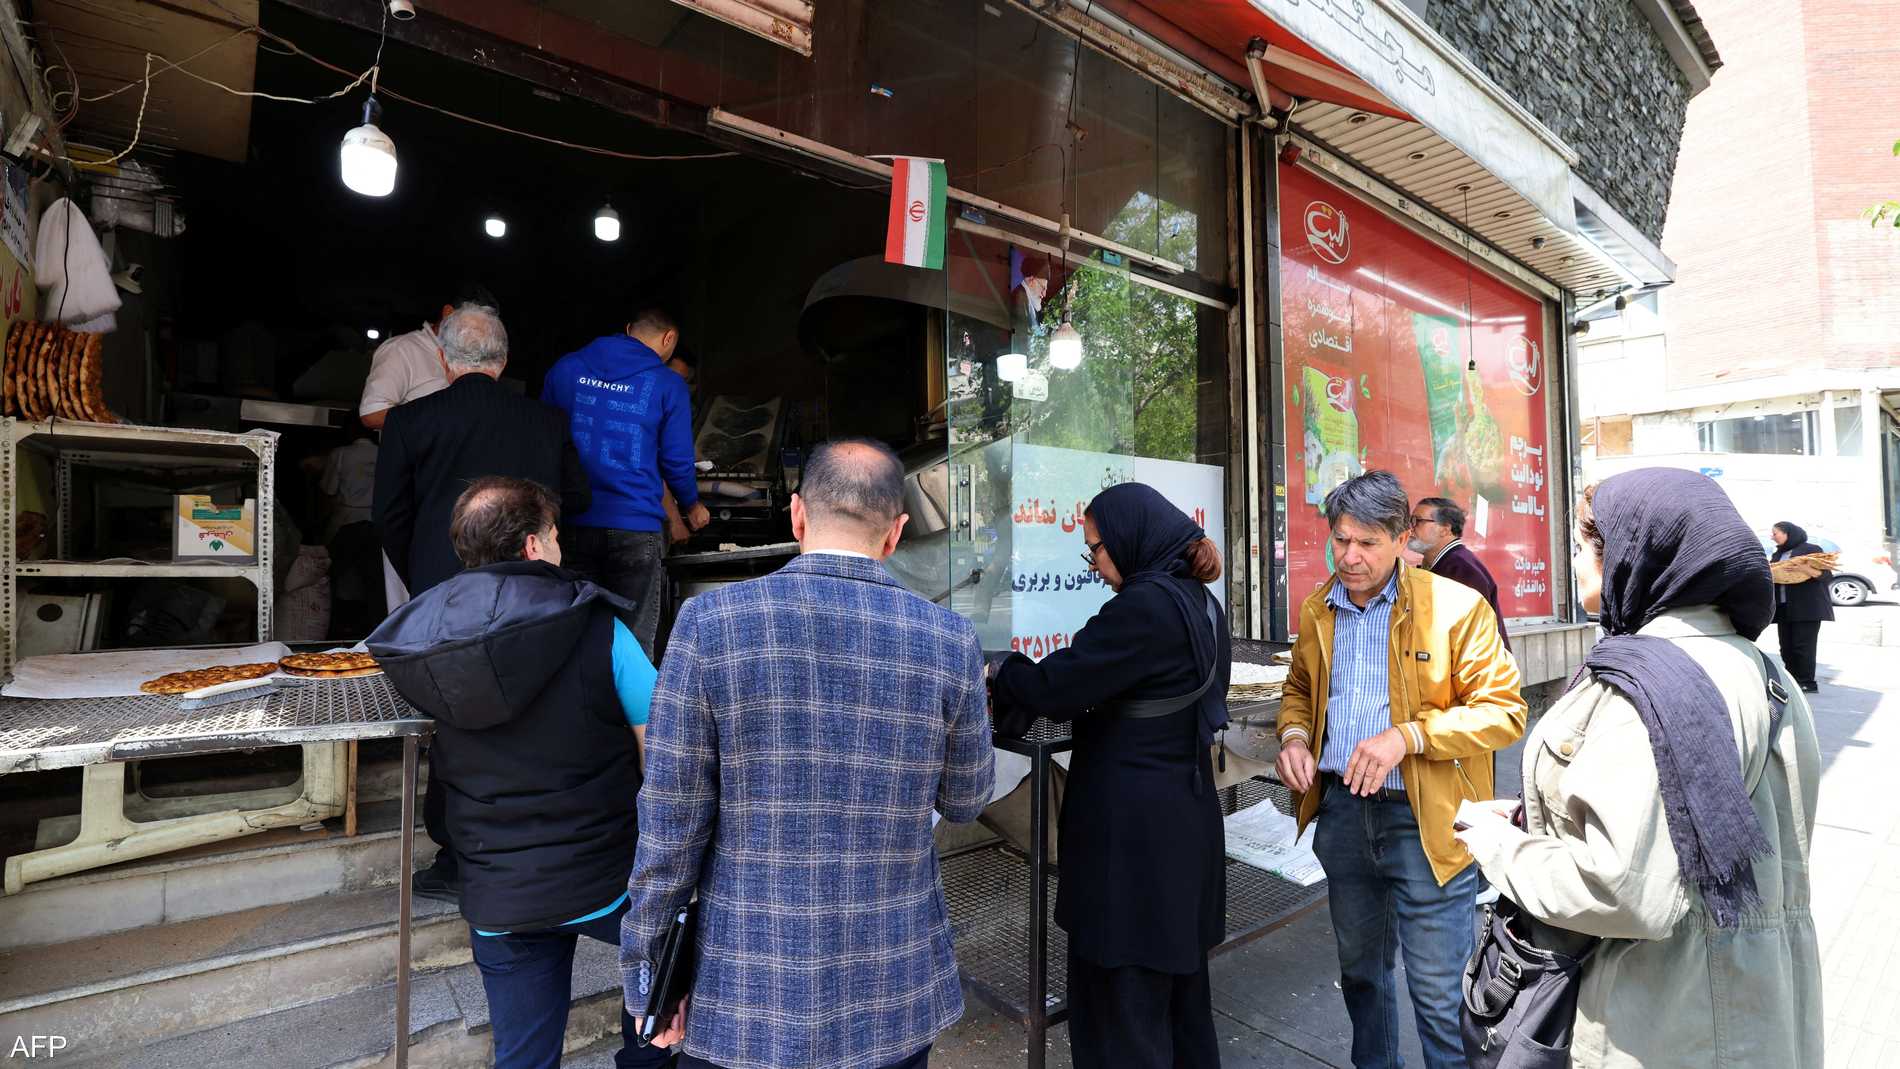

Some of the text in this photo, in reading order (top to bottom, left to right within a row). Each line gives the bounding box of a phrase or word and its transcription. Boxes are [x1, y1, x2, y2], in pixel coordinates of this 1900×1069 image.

[579, 377, 630, 392] GIVENCHY
[1012, 498, 1057, 525] نماند
[1012, 572, 1050, 592] بربری
[1053, 573, 1061, 591] و
